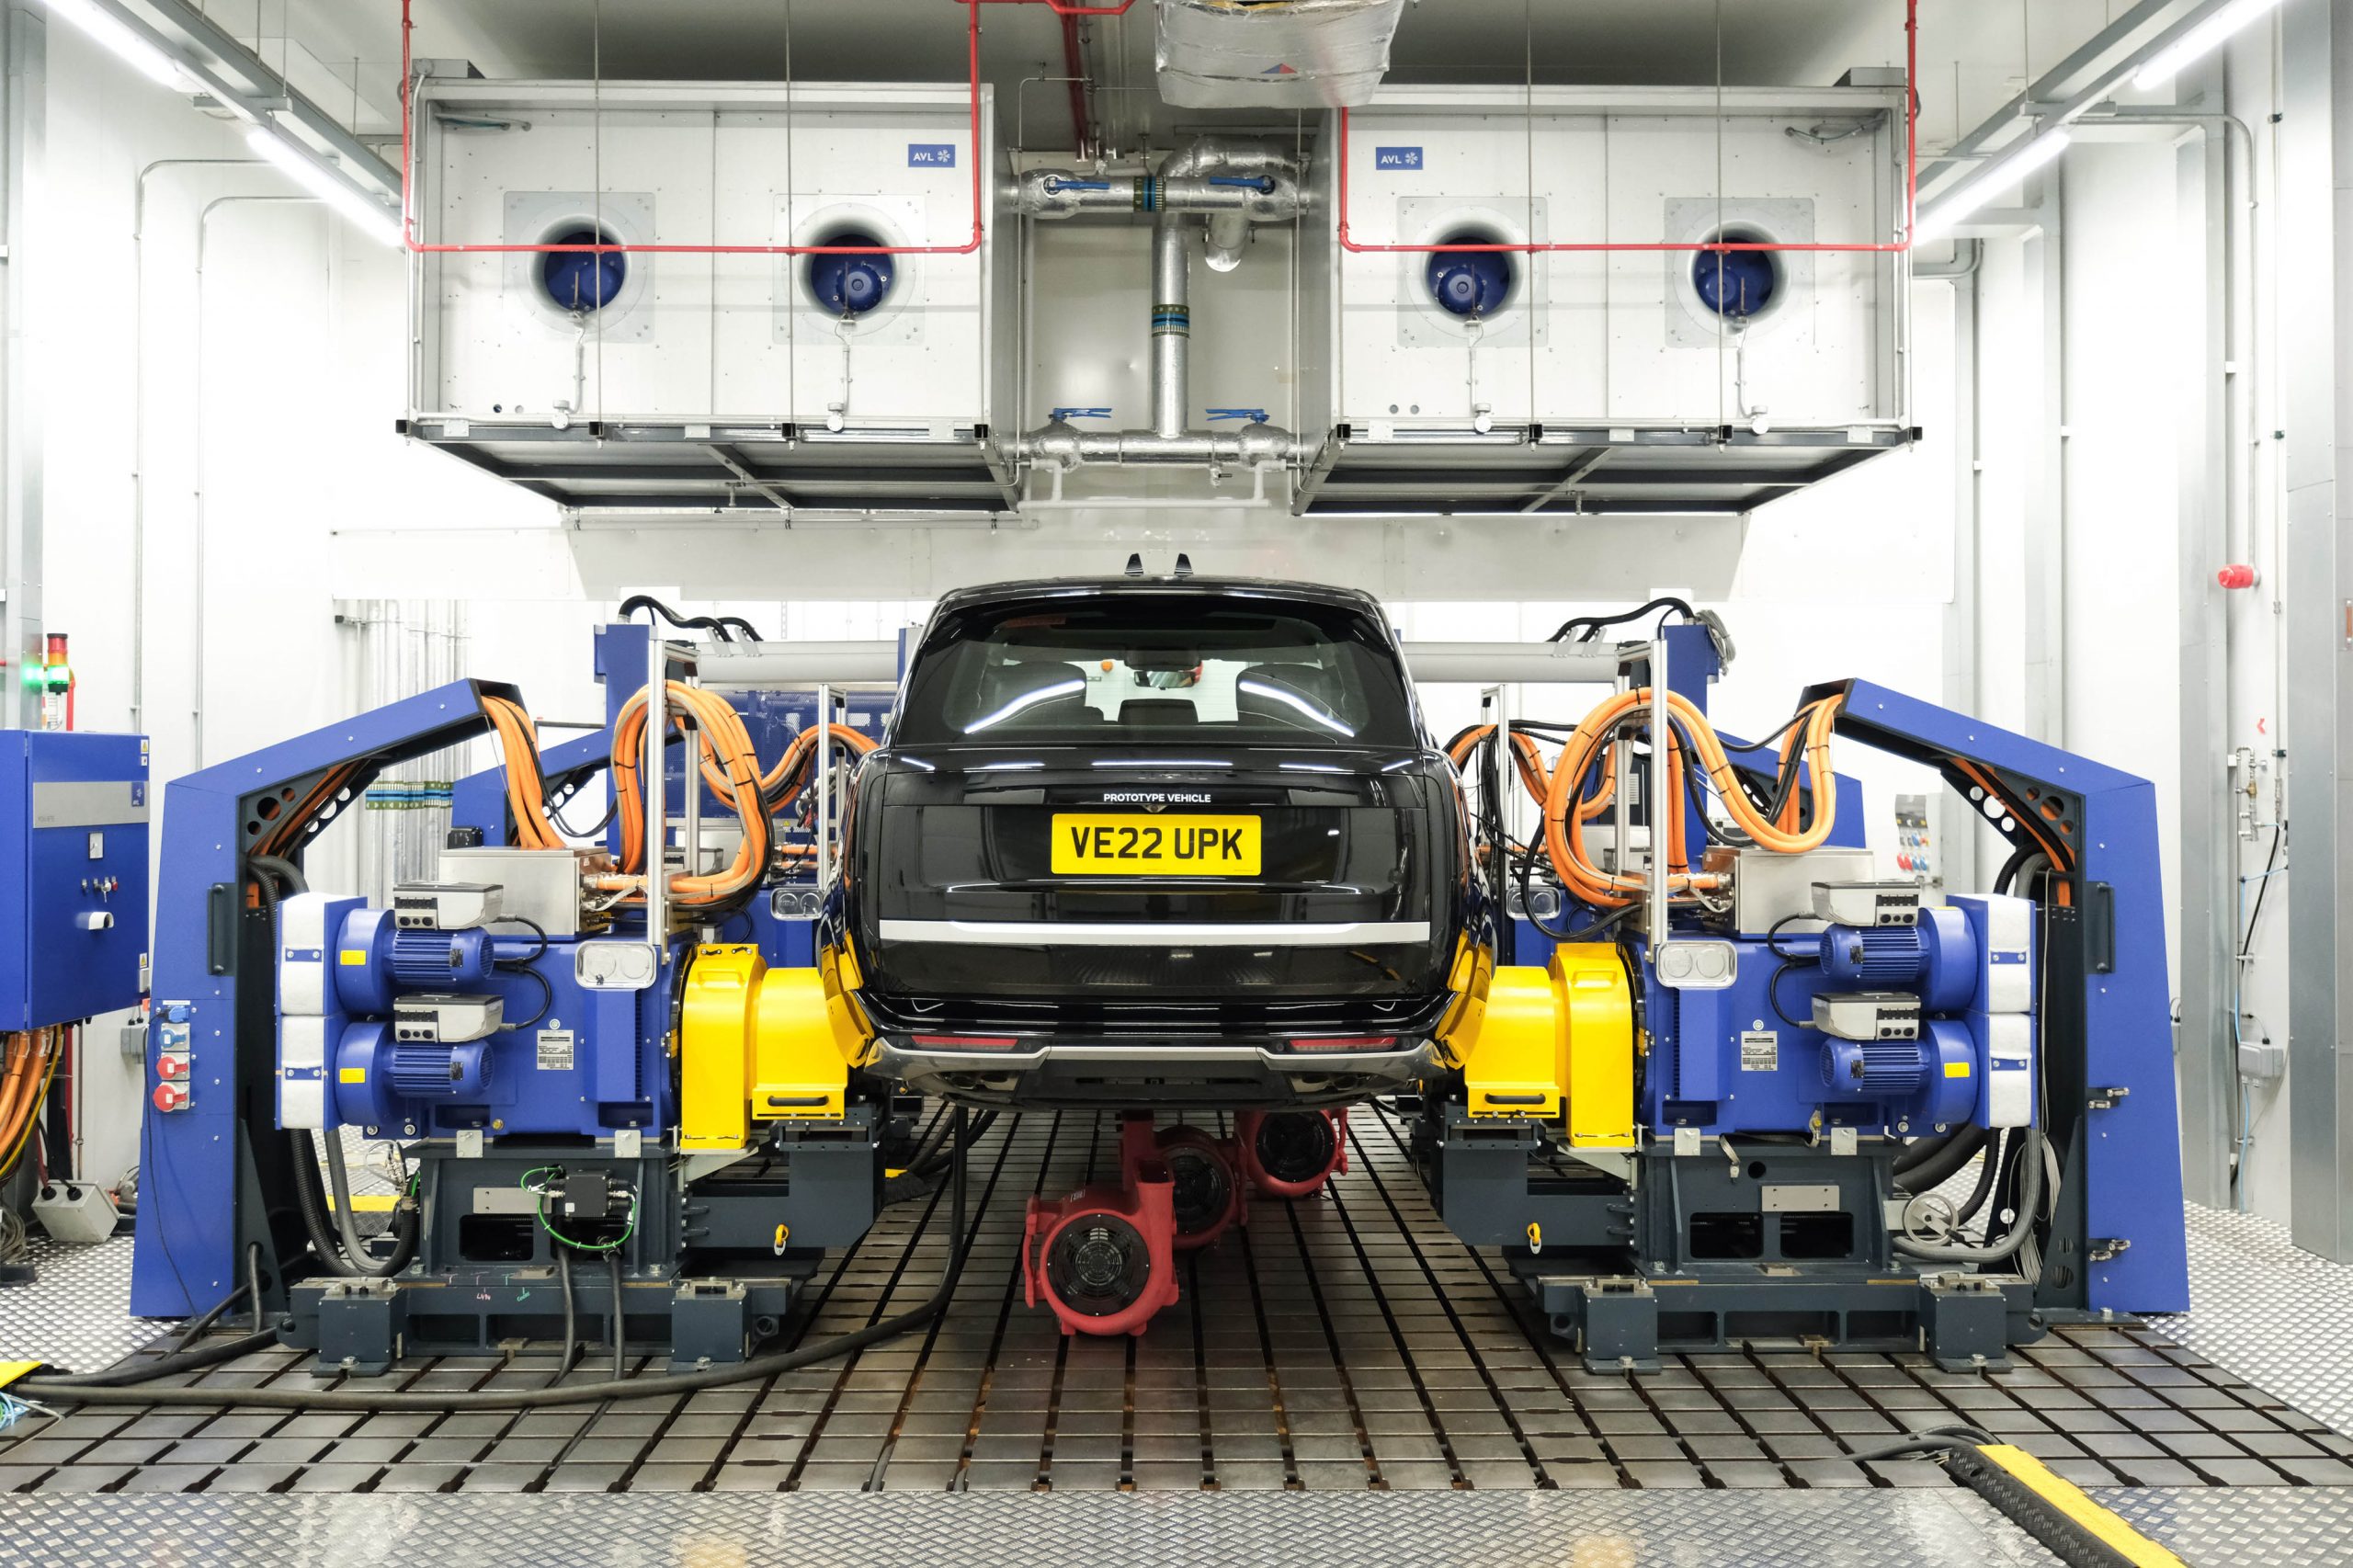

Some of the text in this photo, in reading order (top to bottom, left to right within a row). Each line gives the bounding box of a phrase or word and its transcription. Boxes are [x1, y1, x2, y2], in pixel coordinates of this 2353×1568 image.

[913, 153, 935, 162] AVL
[1380, 155, 1403, 165] AVL
[1103, 793, 1212, 803] PROTOTYPE VEHICLE
[1071, 827, 1243, 860] VE22 UPK
